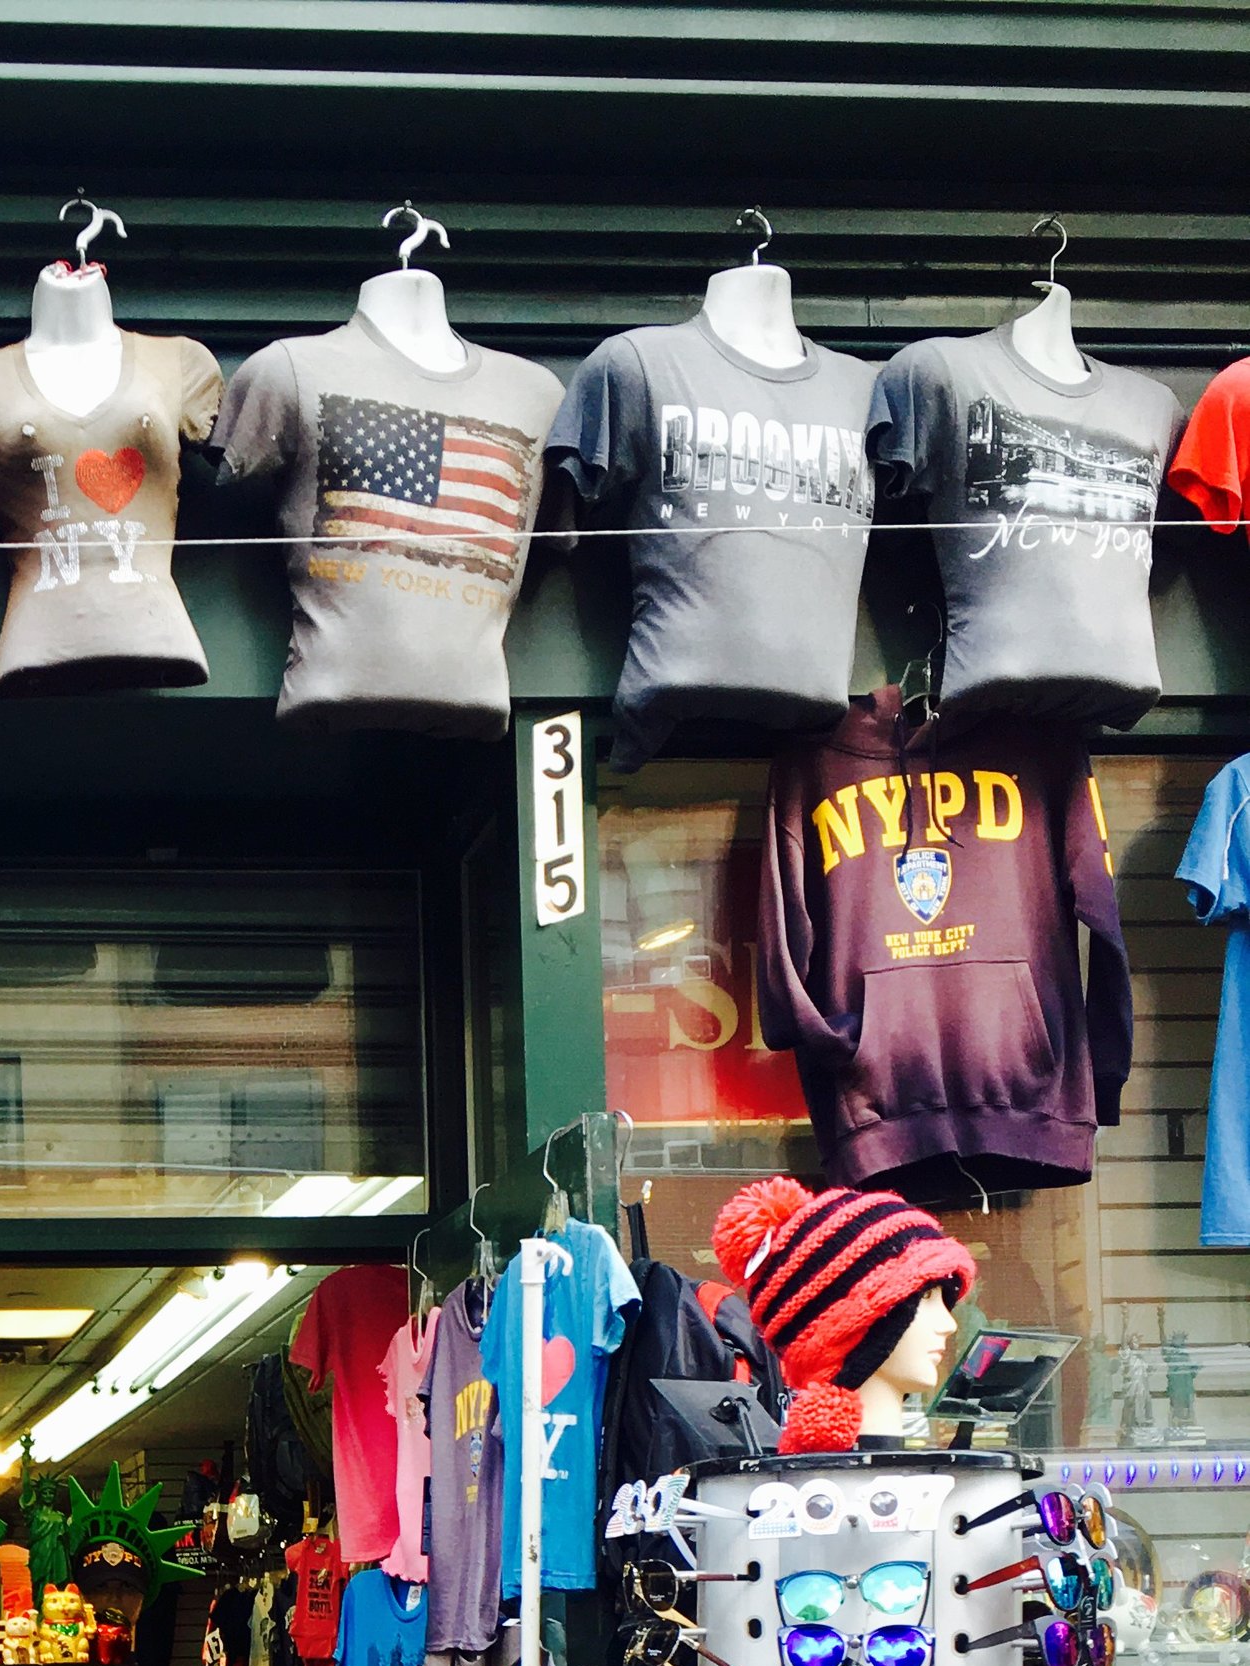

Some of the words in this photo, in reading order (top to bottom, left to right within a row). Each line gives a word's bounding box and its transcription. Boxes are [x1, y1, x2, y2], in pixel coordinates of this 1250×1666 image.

[31, 454, 71, 522] I
[661, 404, 876, 523] BROOKLYN
[660, 502, 751, 521] NEW
[778, 511, 869, 545] YORK
[968, 496, 1078, 560] NEW
[33, 519, 147, 593] NY
[308, 555, 367, 584] NEW
[380, 565, 452, 600] YORK
[541, 723, 578, 914] 315
[812, 770, 1024, 875] NYPD
[905, 851, 937, 862] POLICE
[885, 932, 910, 947] NEW
[913, 930, 941, 944] YORK
[945, 924, 975, 941] CITY
[891, 944, 931, 960] POLICE
[933, 939, 971, 956] DEPT.
[455, 1379, 493, 1441] NYP
